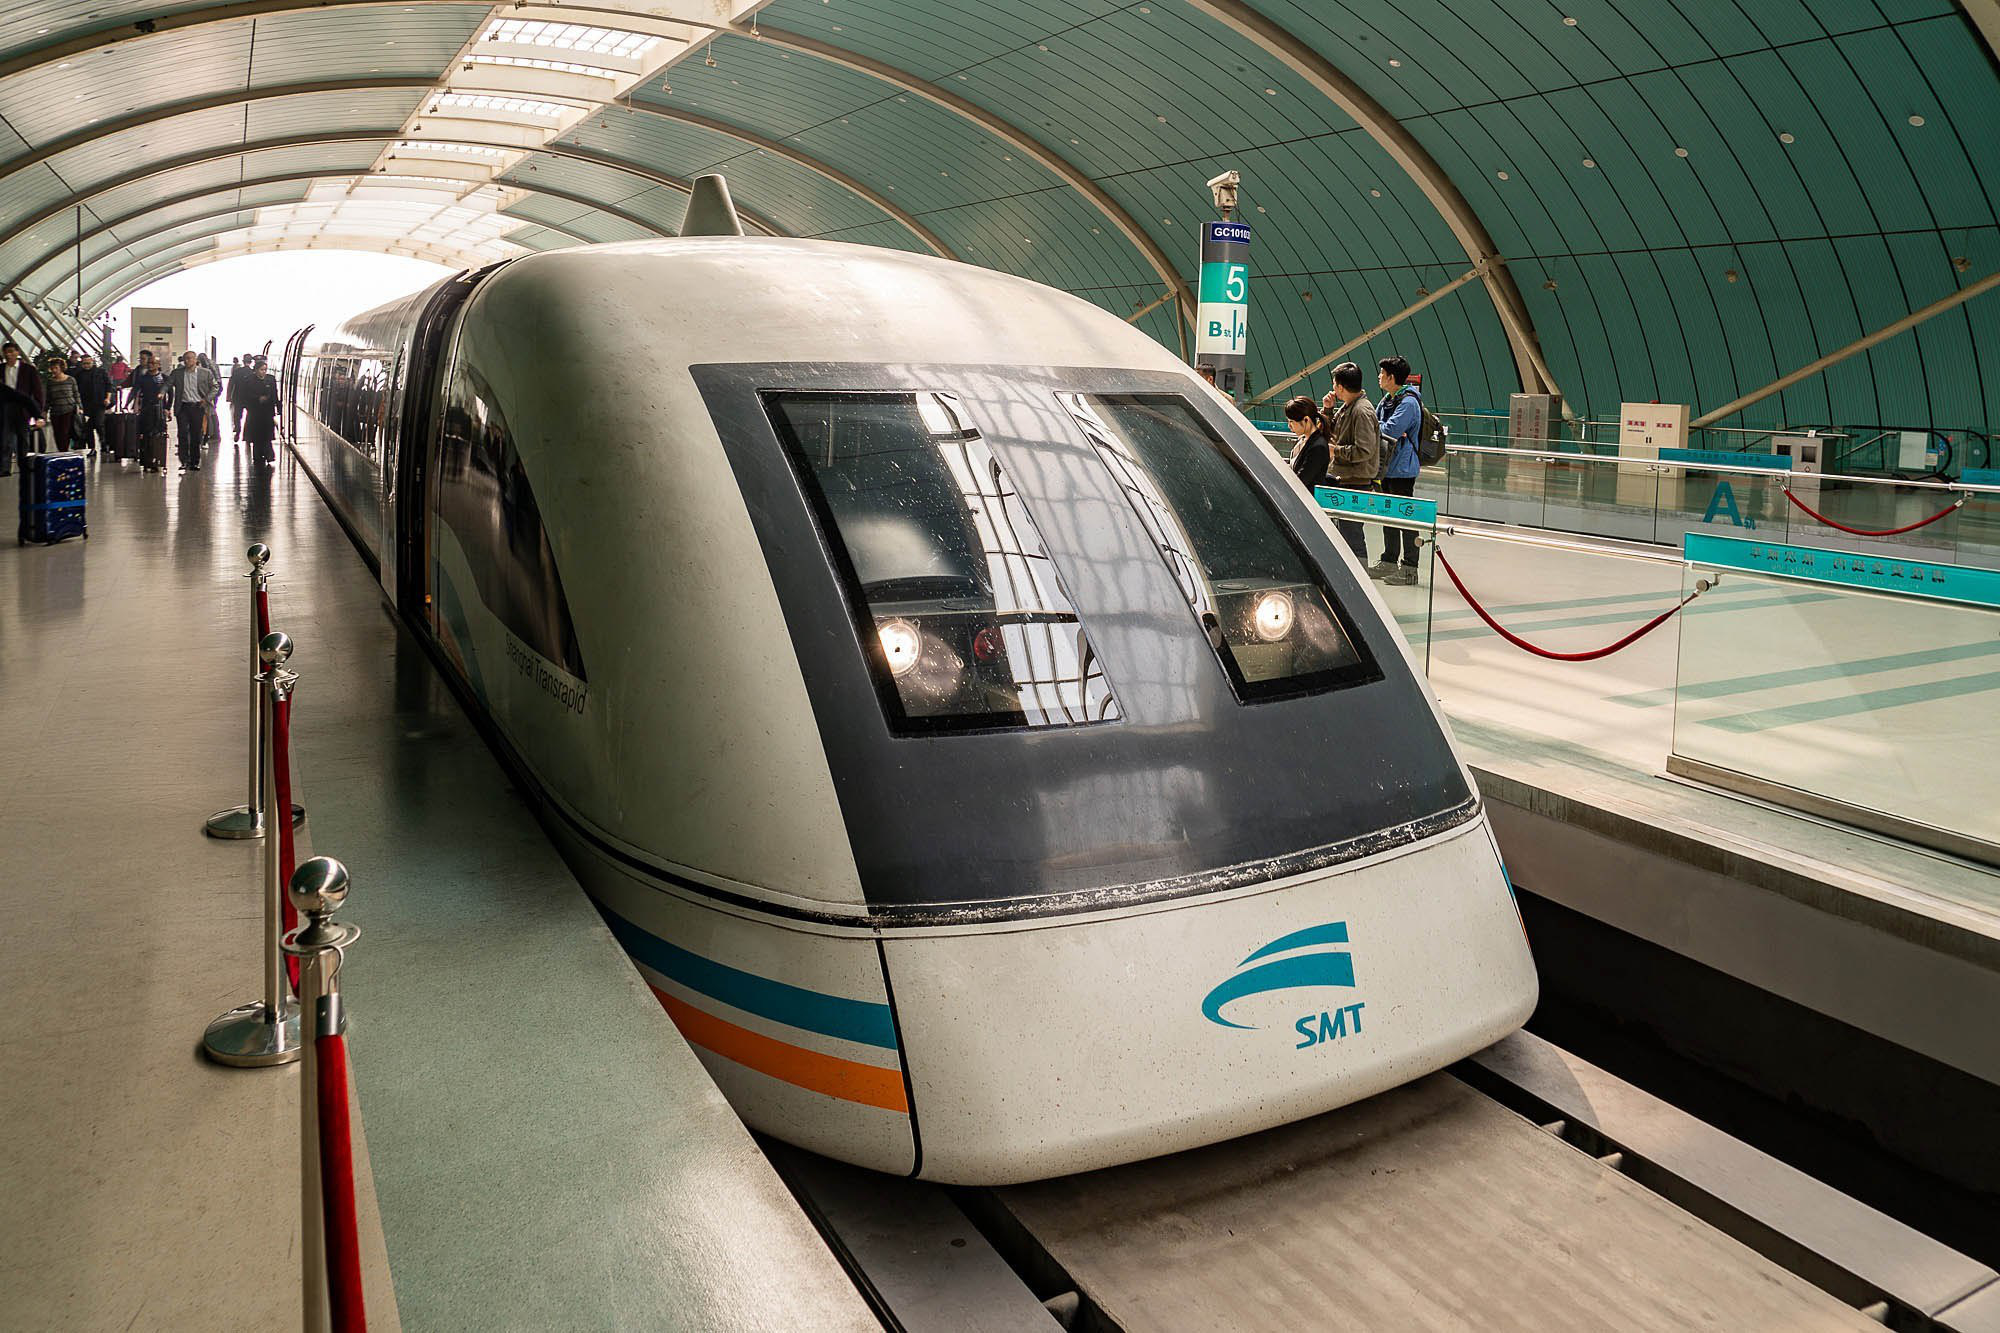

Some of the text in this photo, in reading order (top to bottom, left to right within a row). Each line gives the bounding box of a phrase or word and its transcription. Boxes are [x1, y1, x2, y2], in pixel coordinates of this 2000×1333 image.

[1226, 266, 1245, 301] 5
[535, 658, 588, 714] Transrapid
[1295, 1002, 1366, 1050] SMT
